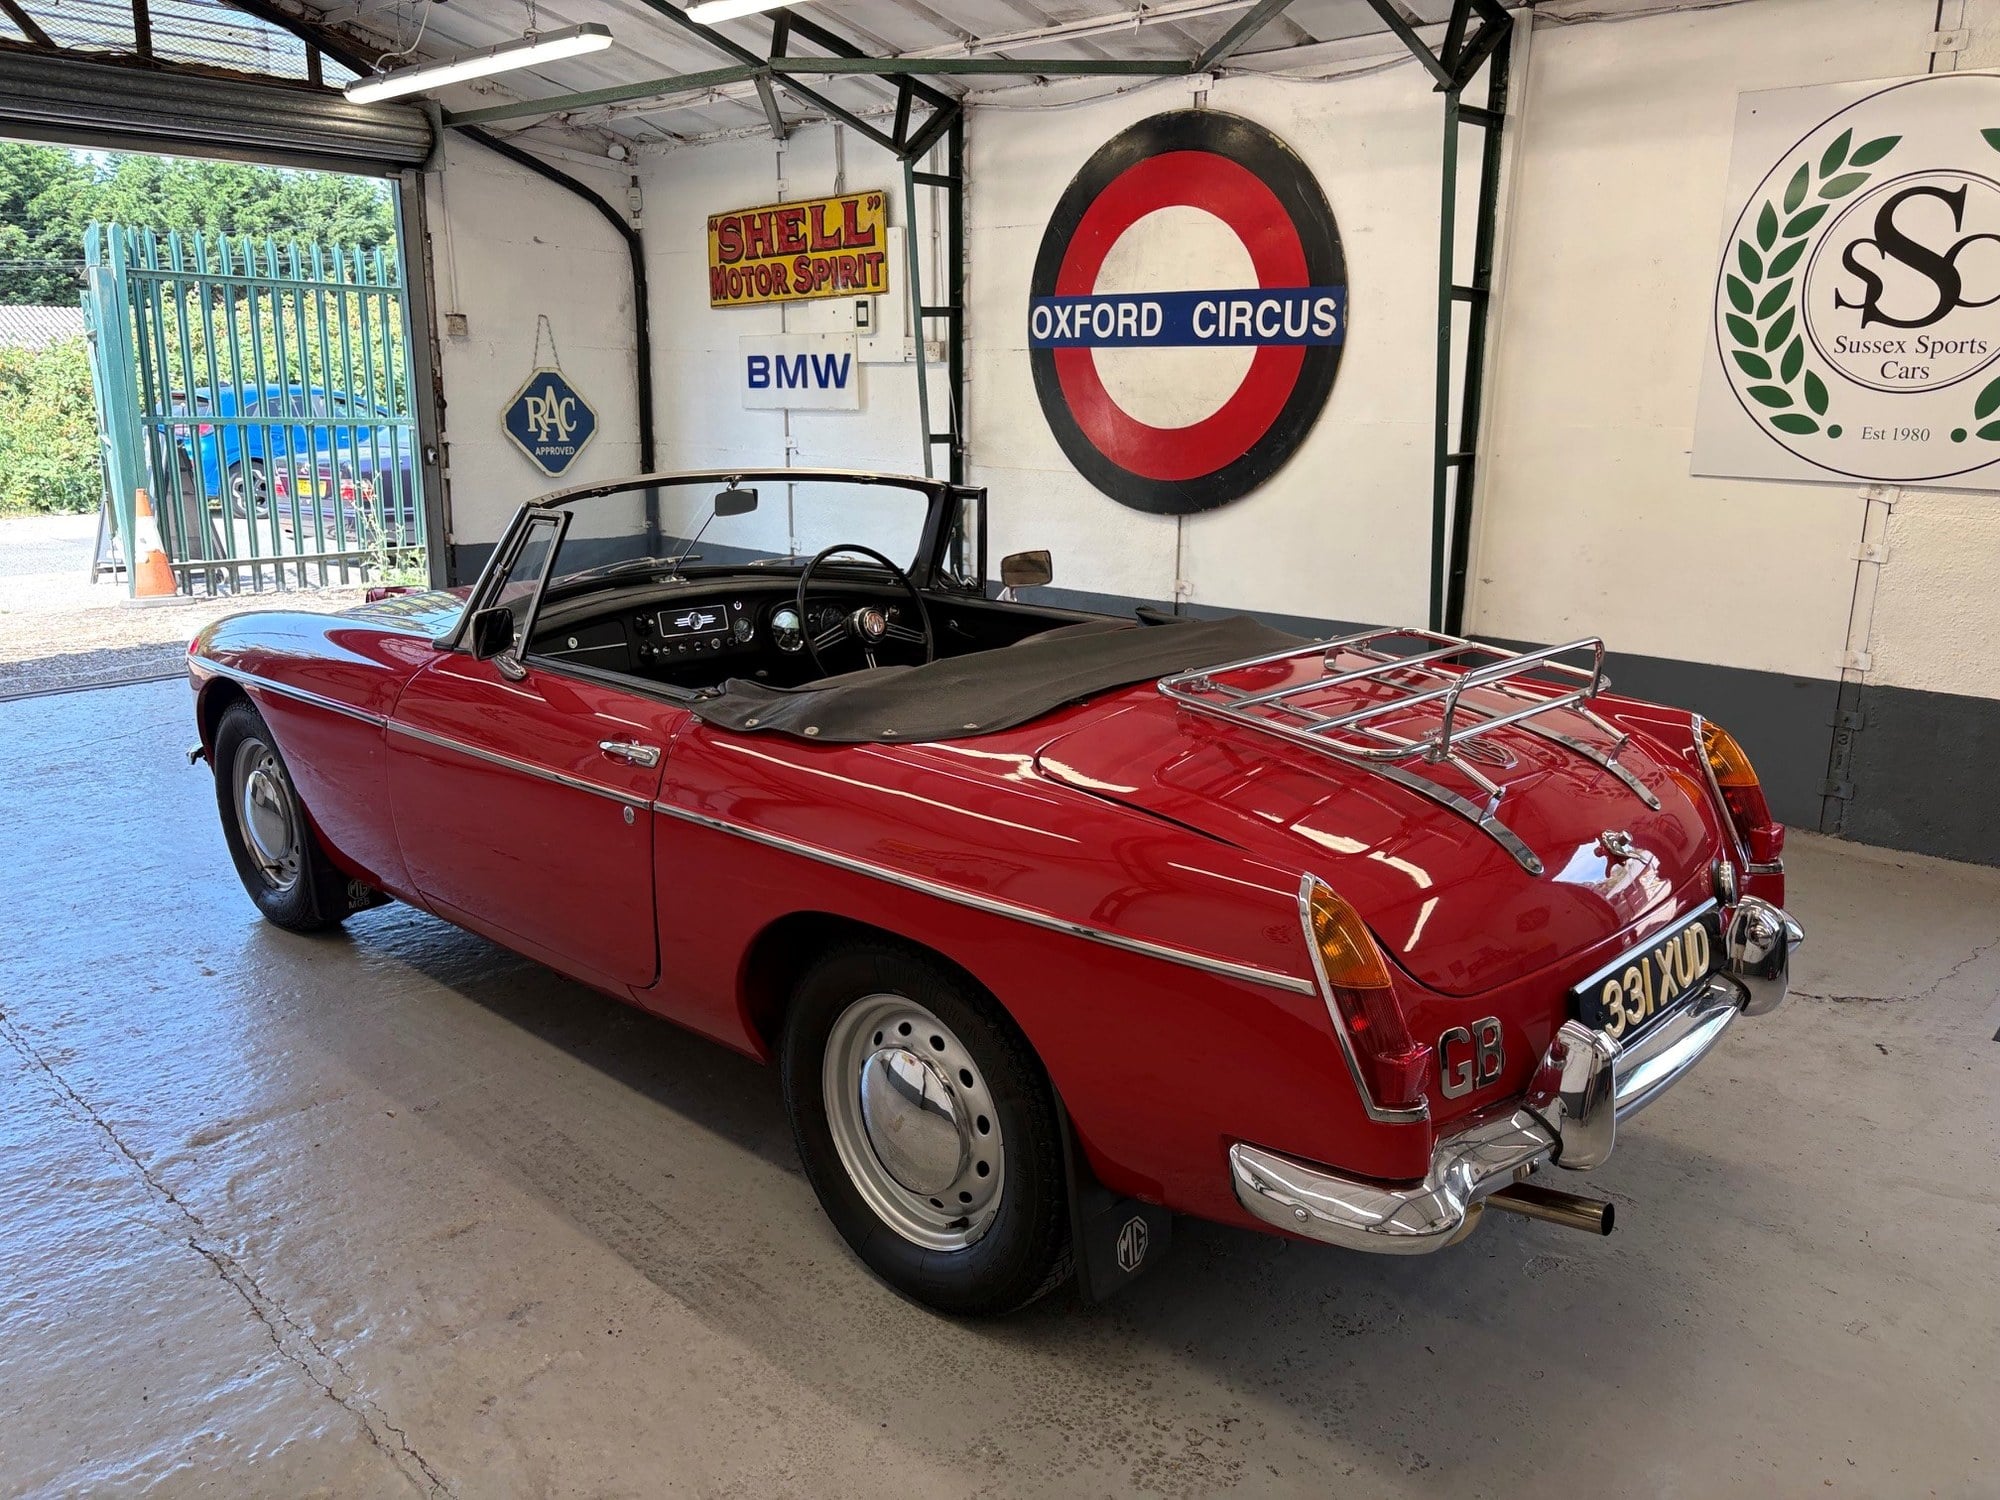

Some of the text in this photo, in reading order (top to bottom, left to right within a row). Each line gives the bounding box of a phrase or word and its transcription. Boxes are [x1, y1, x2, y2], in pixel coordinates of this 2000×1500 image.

[711, 251, 885, 300] MOTOR SPIRIT
[1031, 297, 1338, 340] OXFORD CIRCUS
[1834, 334, 1988, 359] Sussex Sports
[747, 353, 852, 389] BMW
[1880, 360, 1930, 380] Cars
[524, 385, 577, 442] RAC
[1861, 426, 1931, 442] Est 1980
[535, 446, 575, 456] APPROVED
[1602, 921, 1711, 1039] 331 XUD
[1437, 1015, 1507, 1100] GB
[1120, 1220, 1146, 1267] MG
